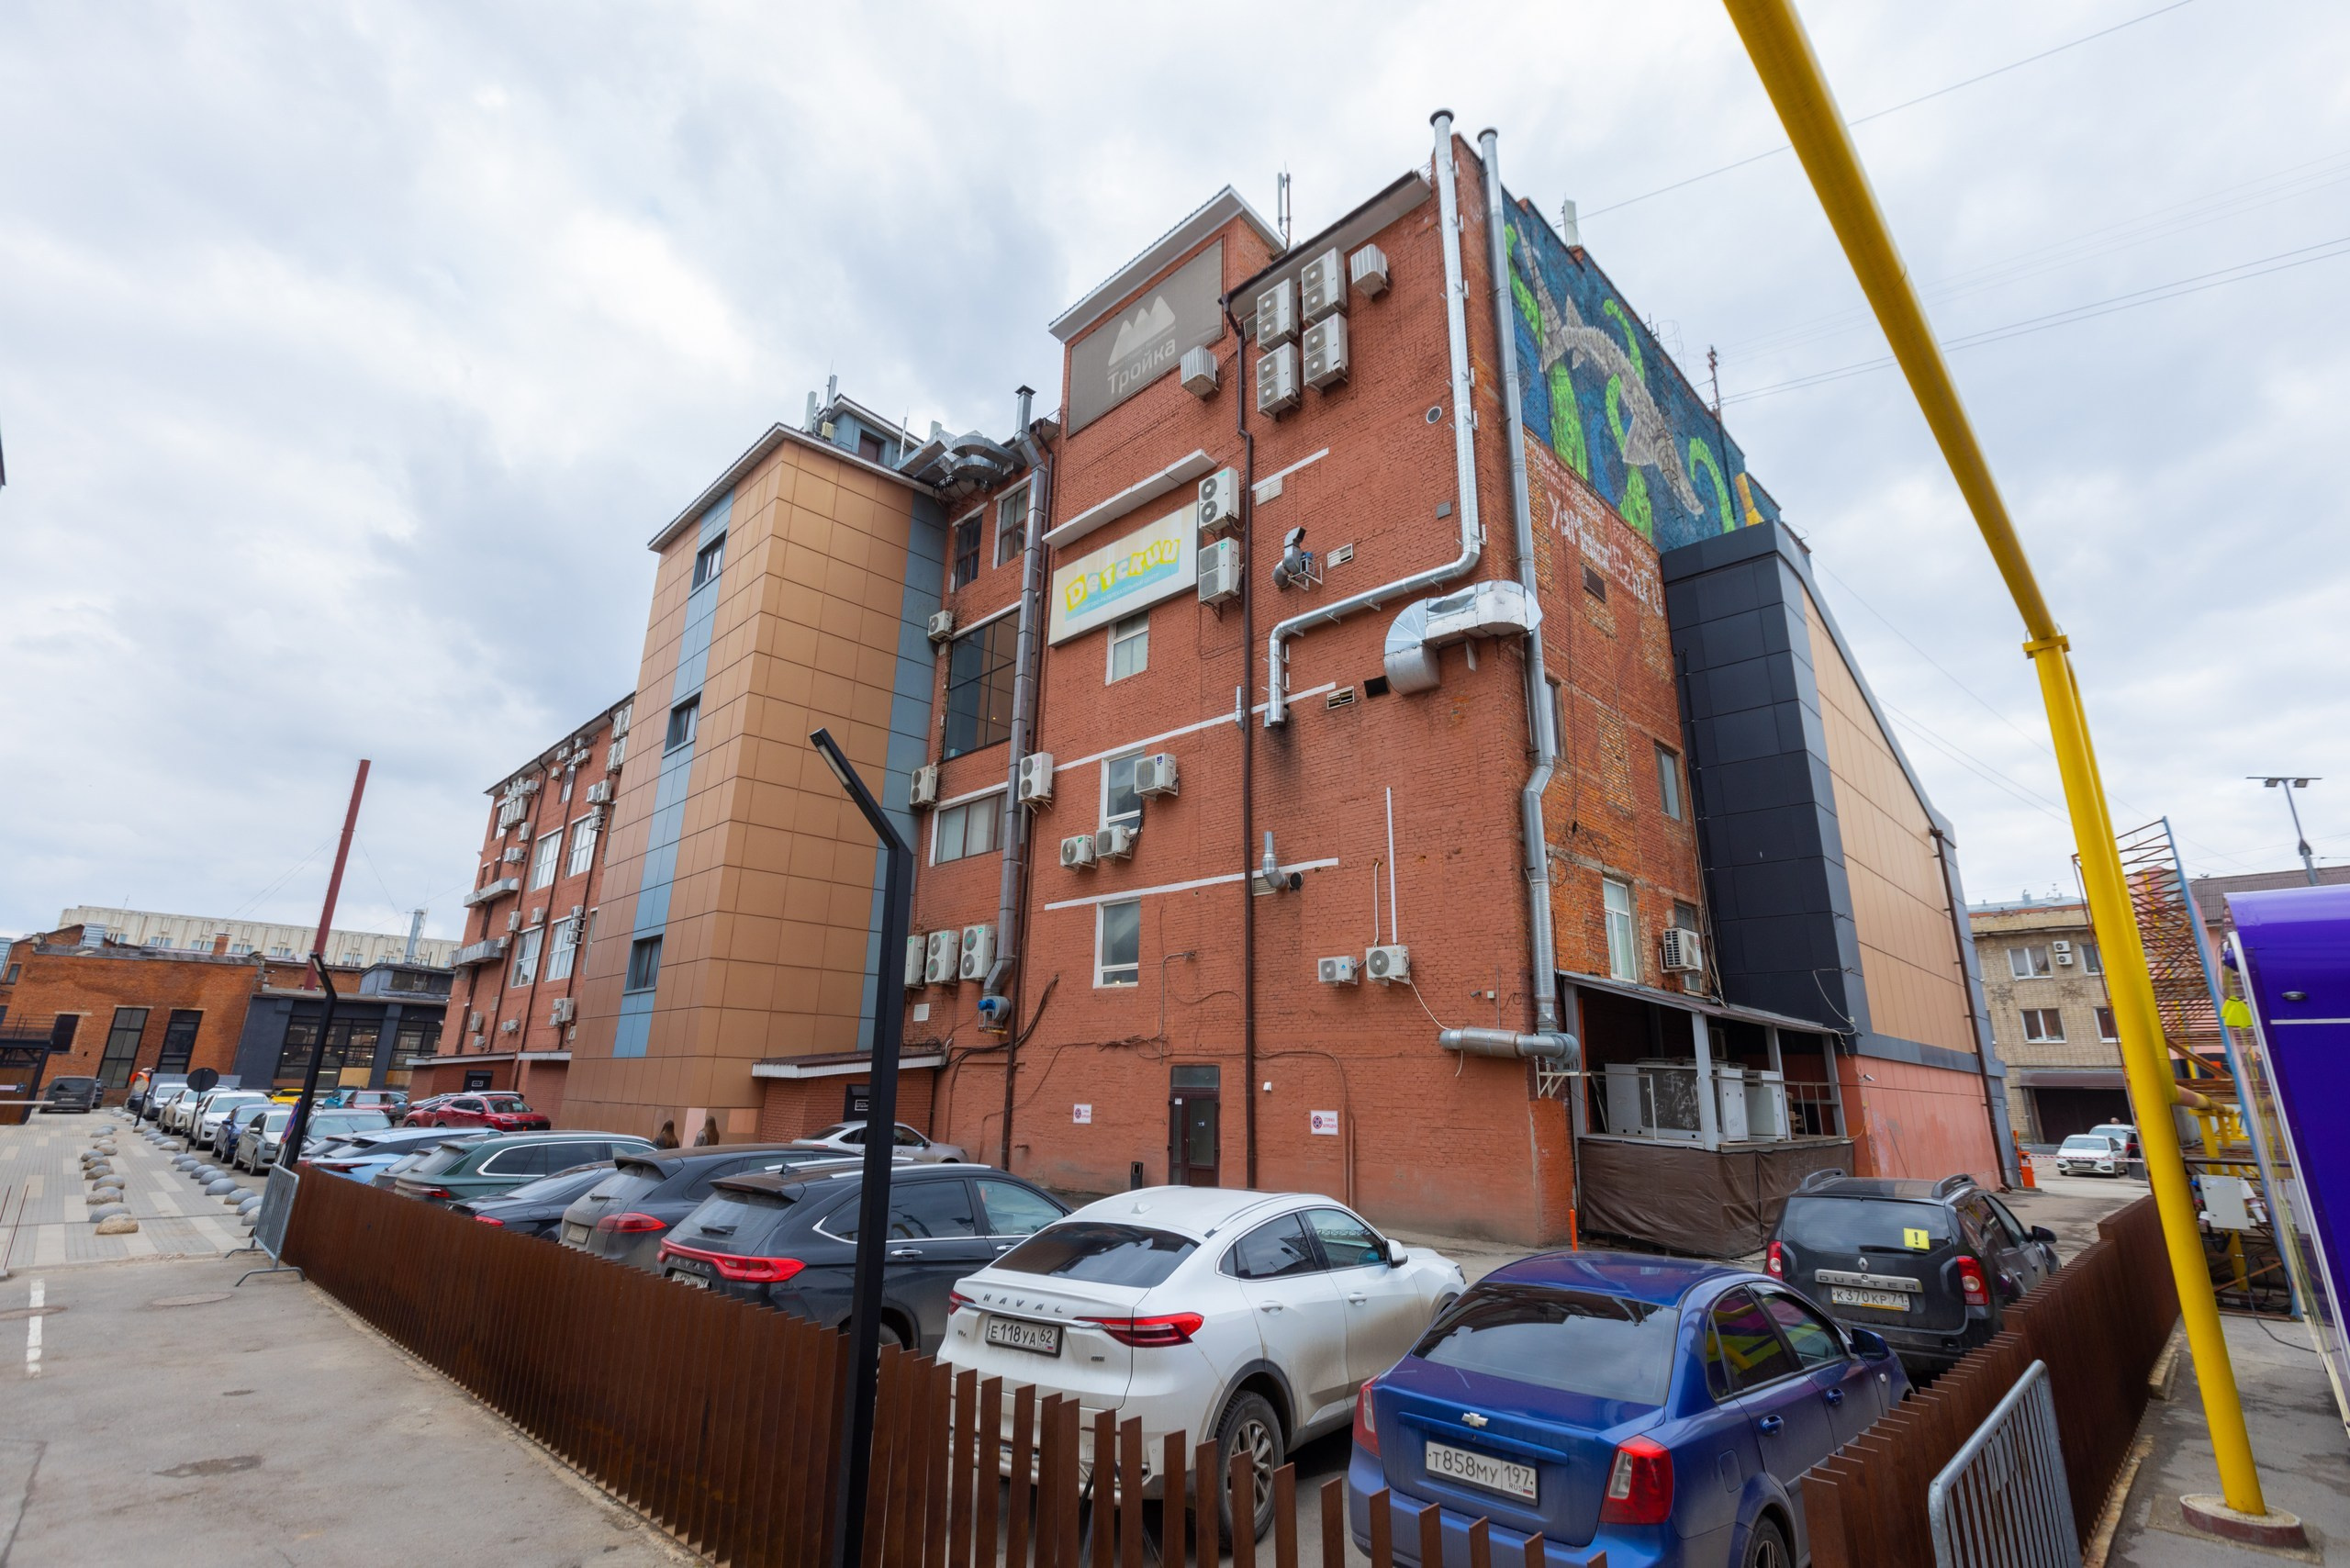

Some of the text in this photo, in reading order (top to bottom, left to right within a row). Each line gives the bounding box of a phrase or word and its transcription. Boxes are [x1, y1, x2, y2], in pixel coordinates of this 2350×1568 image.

[1107, 338, 1176, 394] Тройка
[668, 1255, 711, 1272] HAVAL
[1818, 1274, 1917, 1291] DUSTER
[982, 1294, 1063, 1314] HAVAL
[1039, 1328, 1054, 1344] 62
[1504, 1464, 1530, 1486] 197
[1508, 1483, 1523, 1493] RUS
